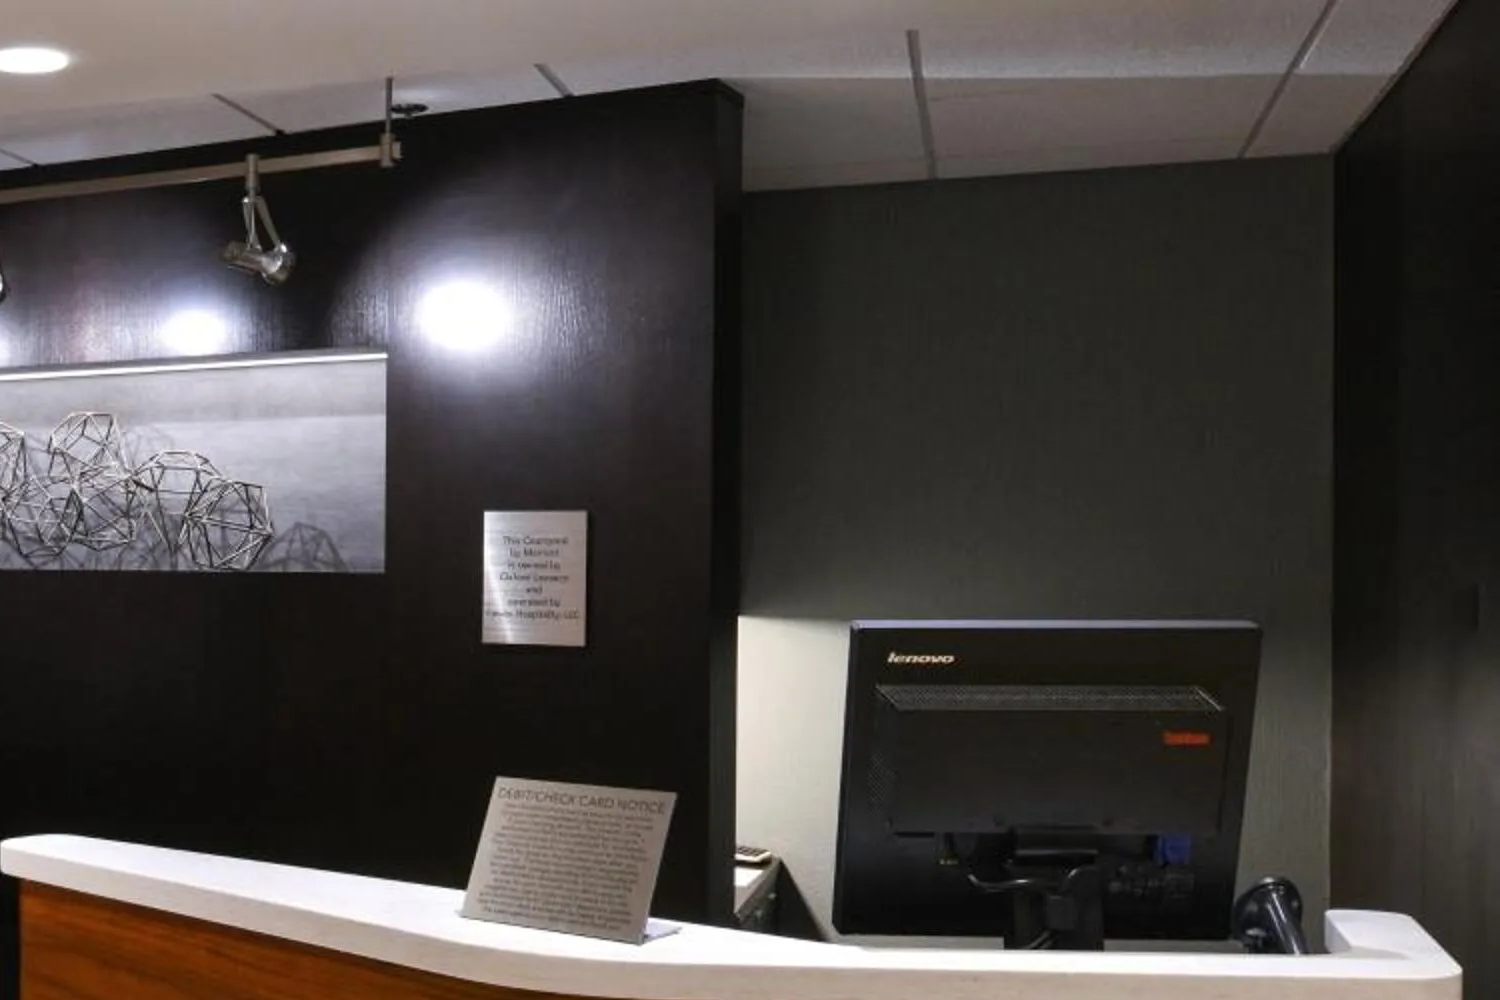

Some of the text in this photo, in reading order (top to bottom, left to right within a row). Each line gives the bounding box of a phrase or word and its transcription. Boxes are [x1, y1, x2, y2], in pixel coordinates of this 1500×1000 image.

[887, 651, 955, 664] lenovo
[579, 794, 616, 809] CARD
[617, 798, 666, 816] NOTICE
